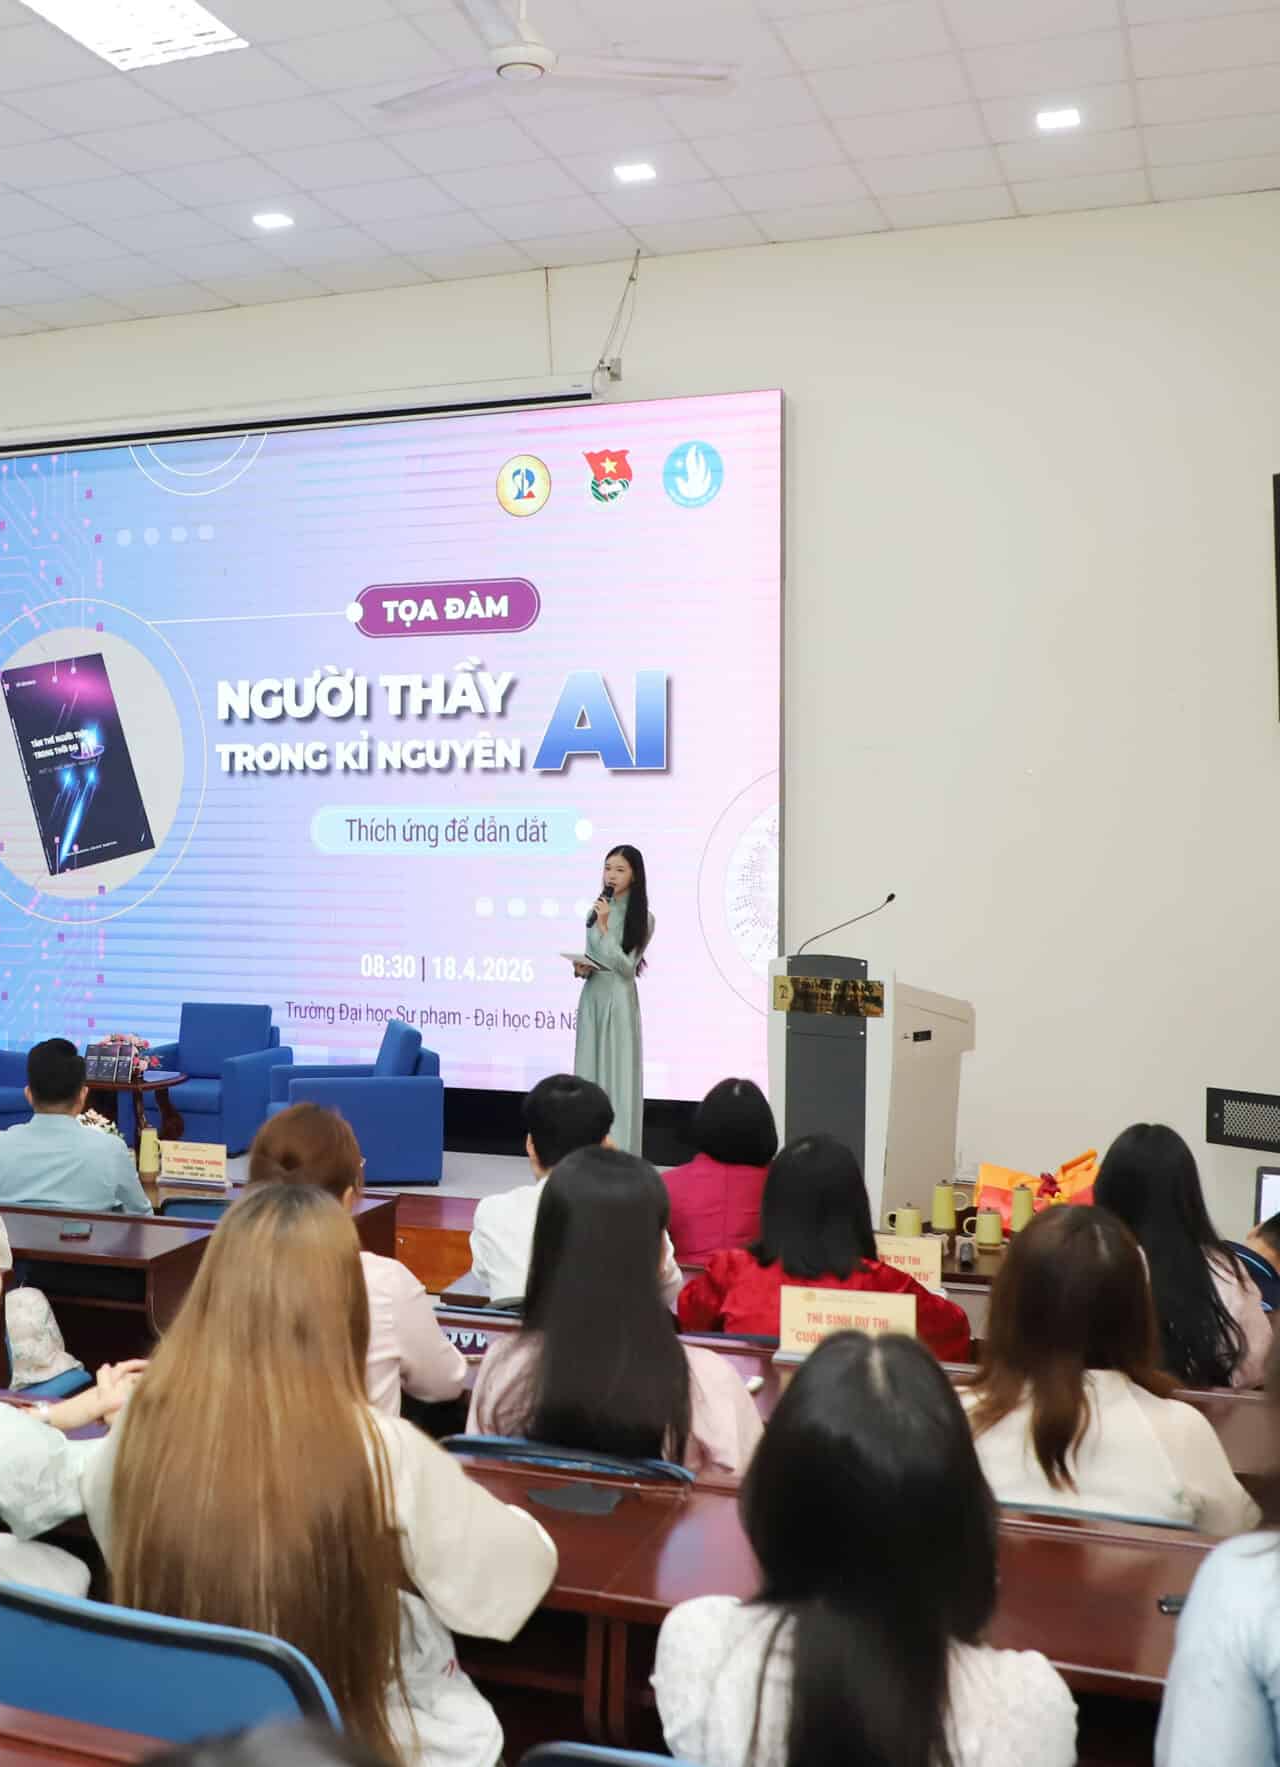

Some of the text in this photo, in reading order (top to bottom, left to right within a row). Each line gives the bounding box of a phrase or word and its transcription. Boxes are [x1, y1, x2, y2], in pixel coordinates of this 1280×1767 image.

[382, 590, 509, 628] TỌA ĐÀM
[217, 656, 514, 719] NGƯỜI THẦY
[532, 668, 668, 771] AI
[215, 739, 328, 772] TRONG
[378, 733, 521, 768] NGUYÊN
[344, 817, 397, 843] Thích
[402, 817, 439, 848] ứng
[444, 815, 470, 842] để
[516, 815, 548, 842] dắt
[360, 953, 416, 978] 08:30
[432, 955, 535, 983] 18.4.2026
[285, 1001, 335, 1025] Trường
[337, 1003, 362, 1025] Đại
[366, 1003, 392, 1026] học
[396, 1005, 416, 1024] Sư
[420, 1004, 461, 1029] phạm
[473, 1008, 498, 1031] Đại
[502, 1007, 530, 1032] học
[534, 1010, 556, 1030] Đà
